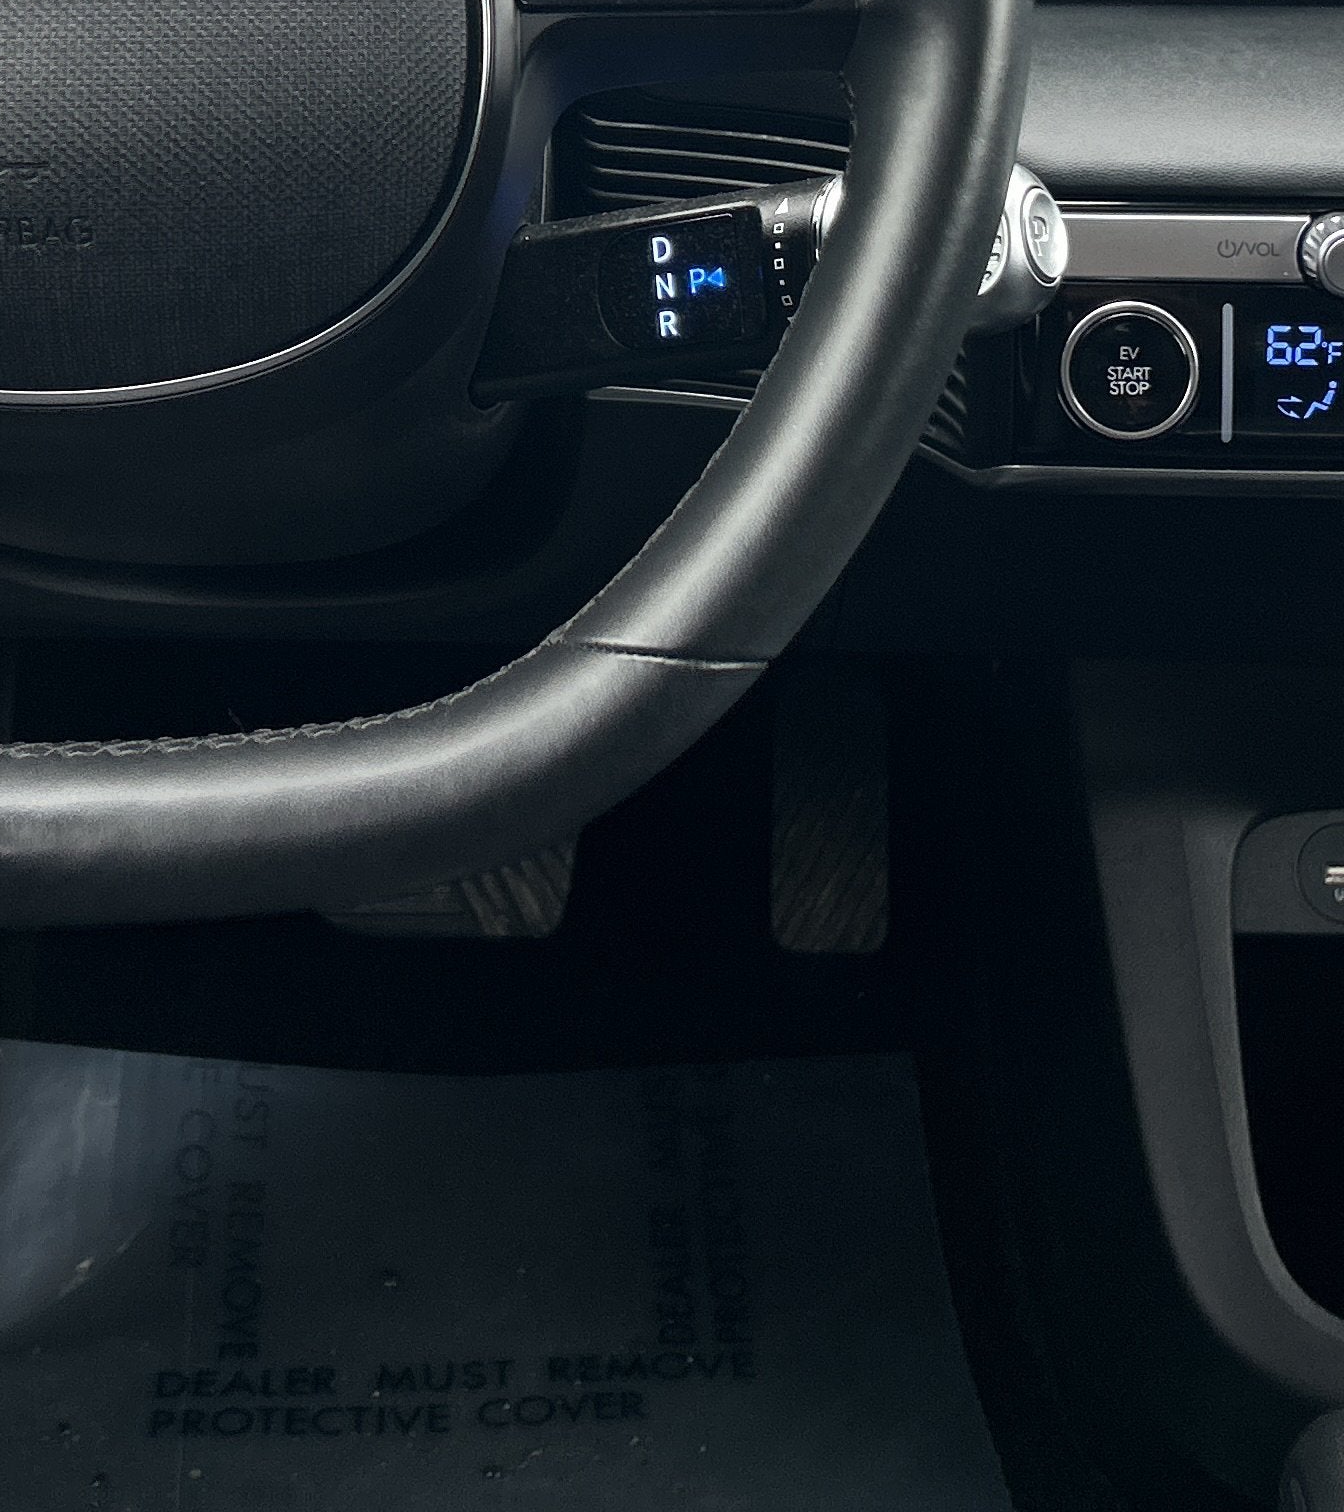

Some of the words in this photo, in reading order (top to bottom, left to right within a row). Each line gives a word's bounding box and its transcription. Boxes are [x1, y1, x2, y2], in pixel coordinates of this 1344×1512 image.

[651, 236, 672, 263] D
[655, 272, 674, 300] N
[689, 268, 705, 294] P
[658, 310, 679, 338] R
[1119, 345, 1140, 361] EV
[1107, 365, 1152, 382] START
[1109, 381, 1151, 396] STOP
[151, 1365, 338, 1400] DEALER
[376, 1358, 515, 1393] MUST
[547, 1349, 758, 1384] REMOVE
[146, 1402, 450, 1439] PROTECTIVE
[476, 1390, 647, 1432] COVER
